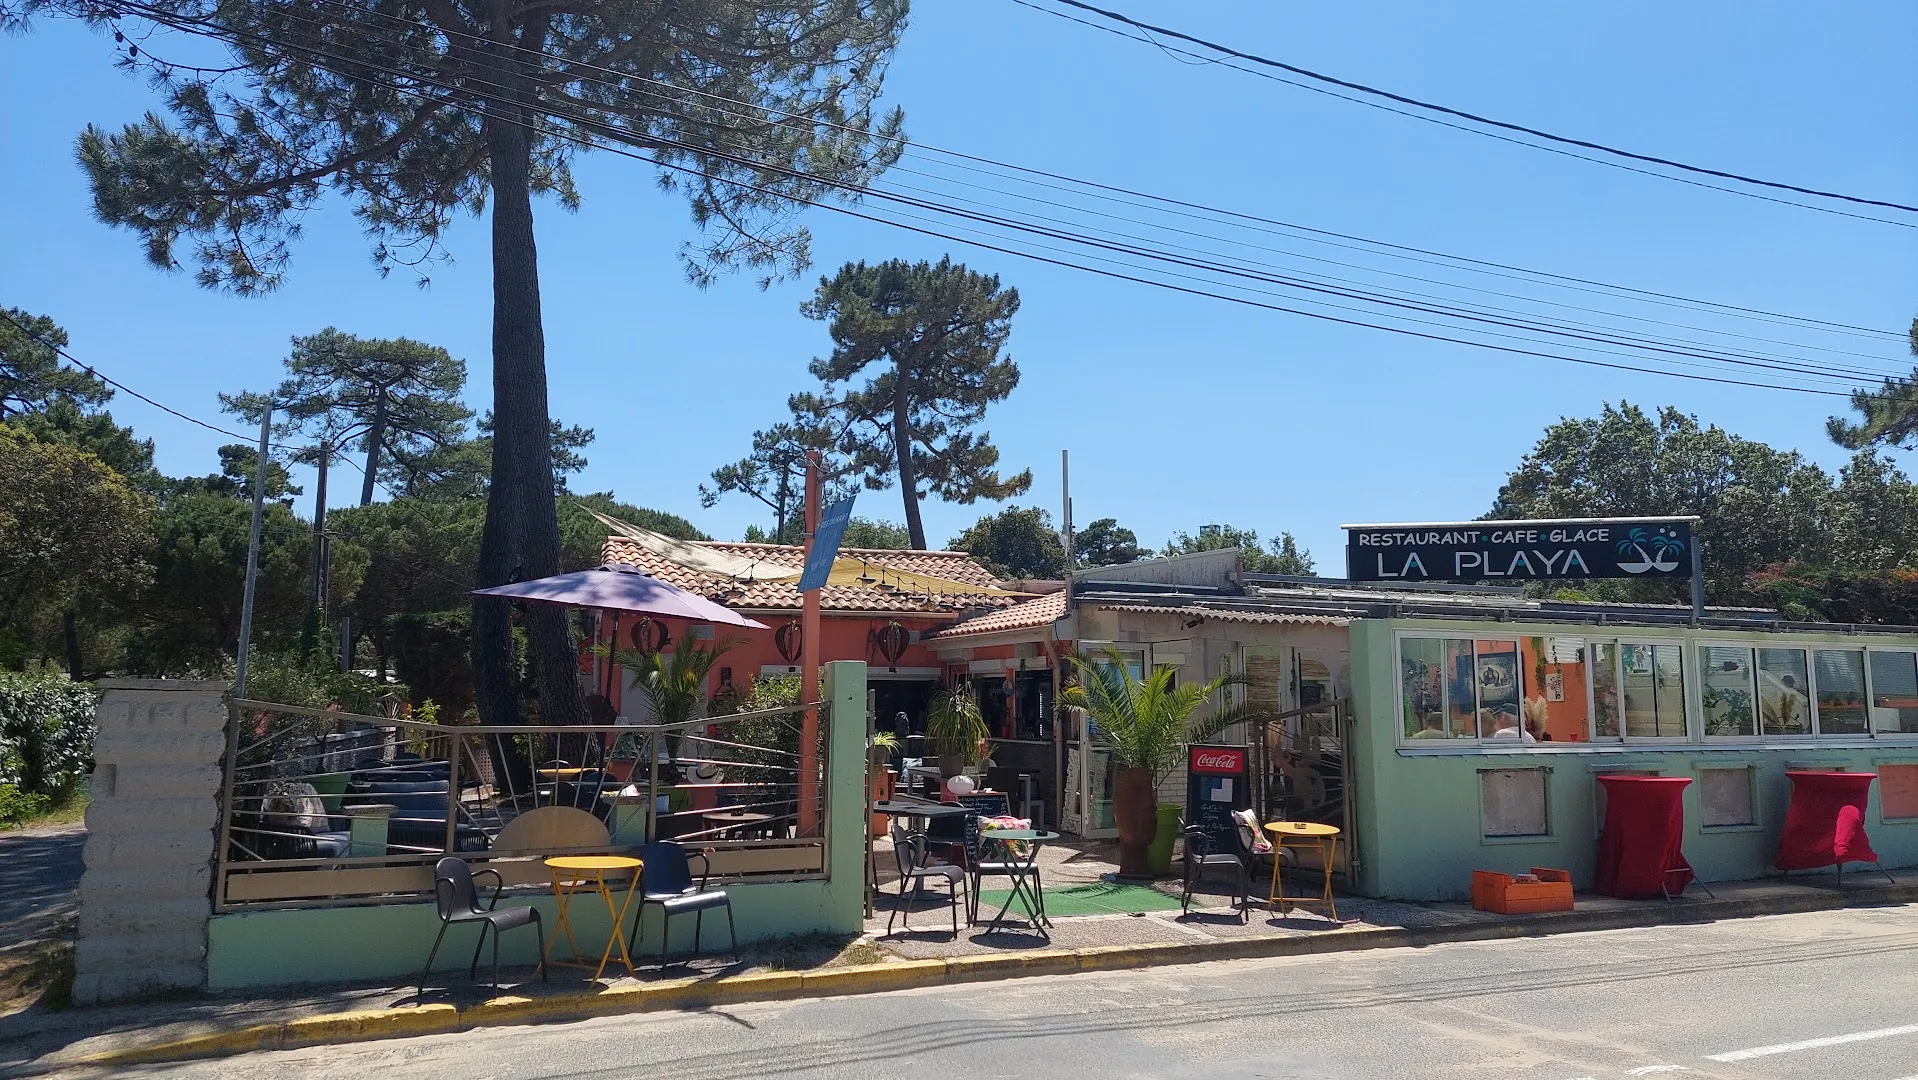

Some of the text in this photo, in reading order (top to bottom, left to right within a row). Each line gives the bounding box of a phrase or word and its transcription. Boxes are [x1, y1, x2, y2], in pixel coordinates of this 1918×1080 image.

[1359, 529, 1610, 547] RESTAURANT CAFE GLACE
[1378, 549, 1591, 577] LA PLAYA
